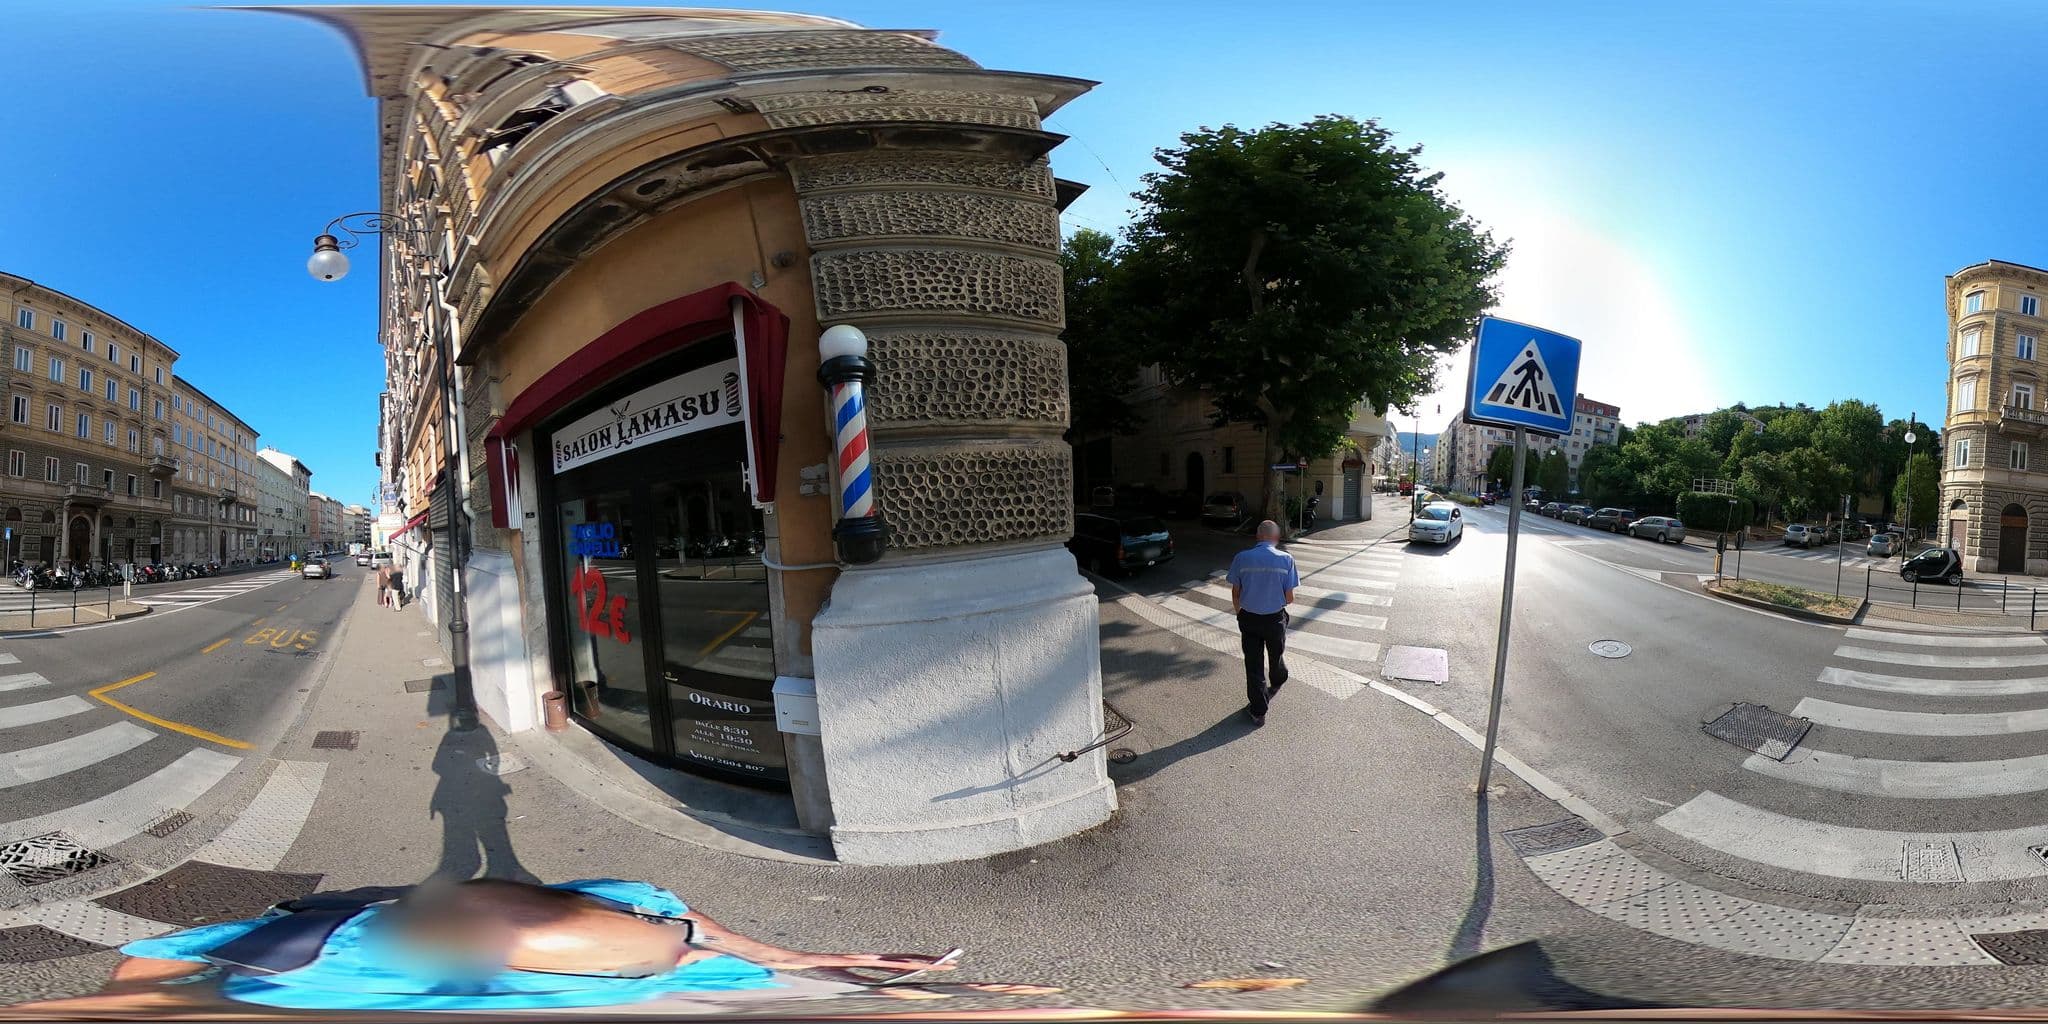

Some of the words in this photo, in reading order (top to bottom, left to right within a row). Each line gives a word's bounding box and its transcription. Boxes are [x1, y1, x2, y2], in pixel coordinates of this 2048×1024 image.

[564, 426, 612, 462] SALON
[616, 389, 720, 442] LAMASU
[243, 628, 320, 650] BUS
[689, 692, 751, 714] ORARIO
[694, 729, 715, 737] ALLE
[695, 720, 721, 731] DALLE
[722, 725, 749, 736] 8:30
